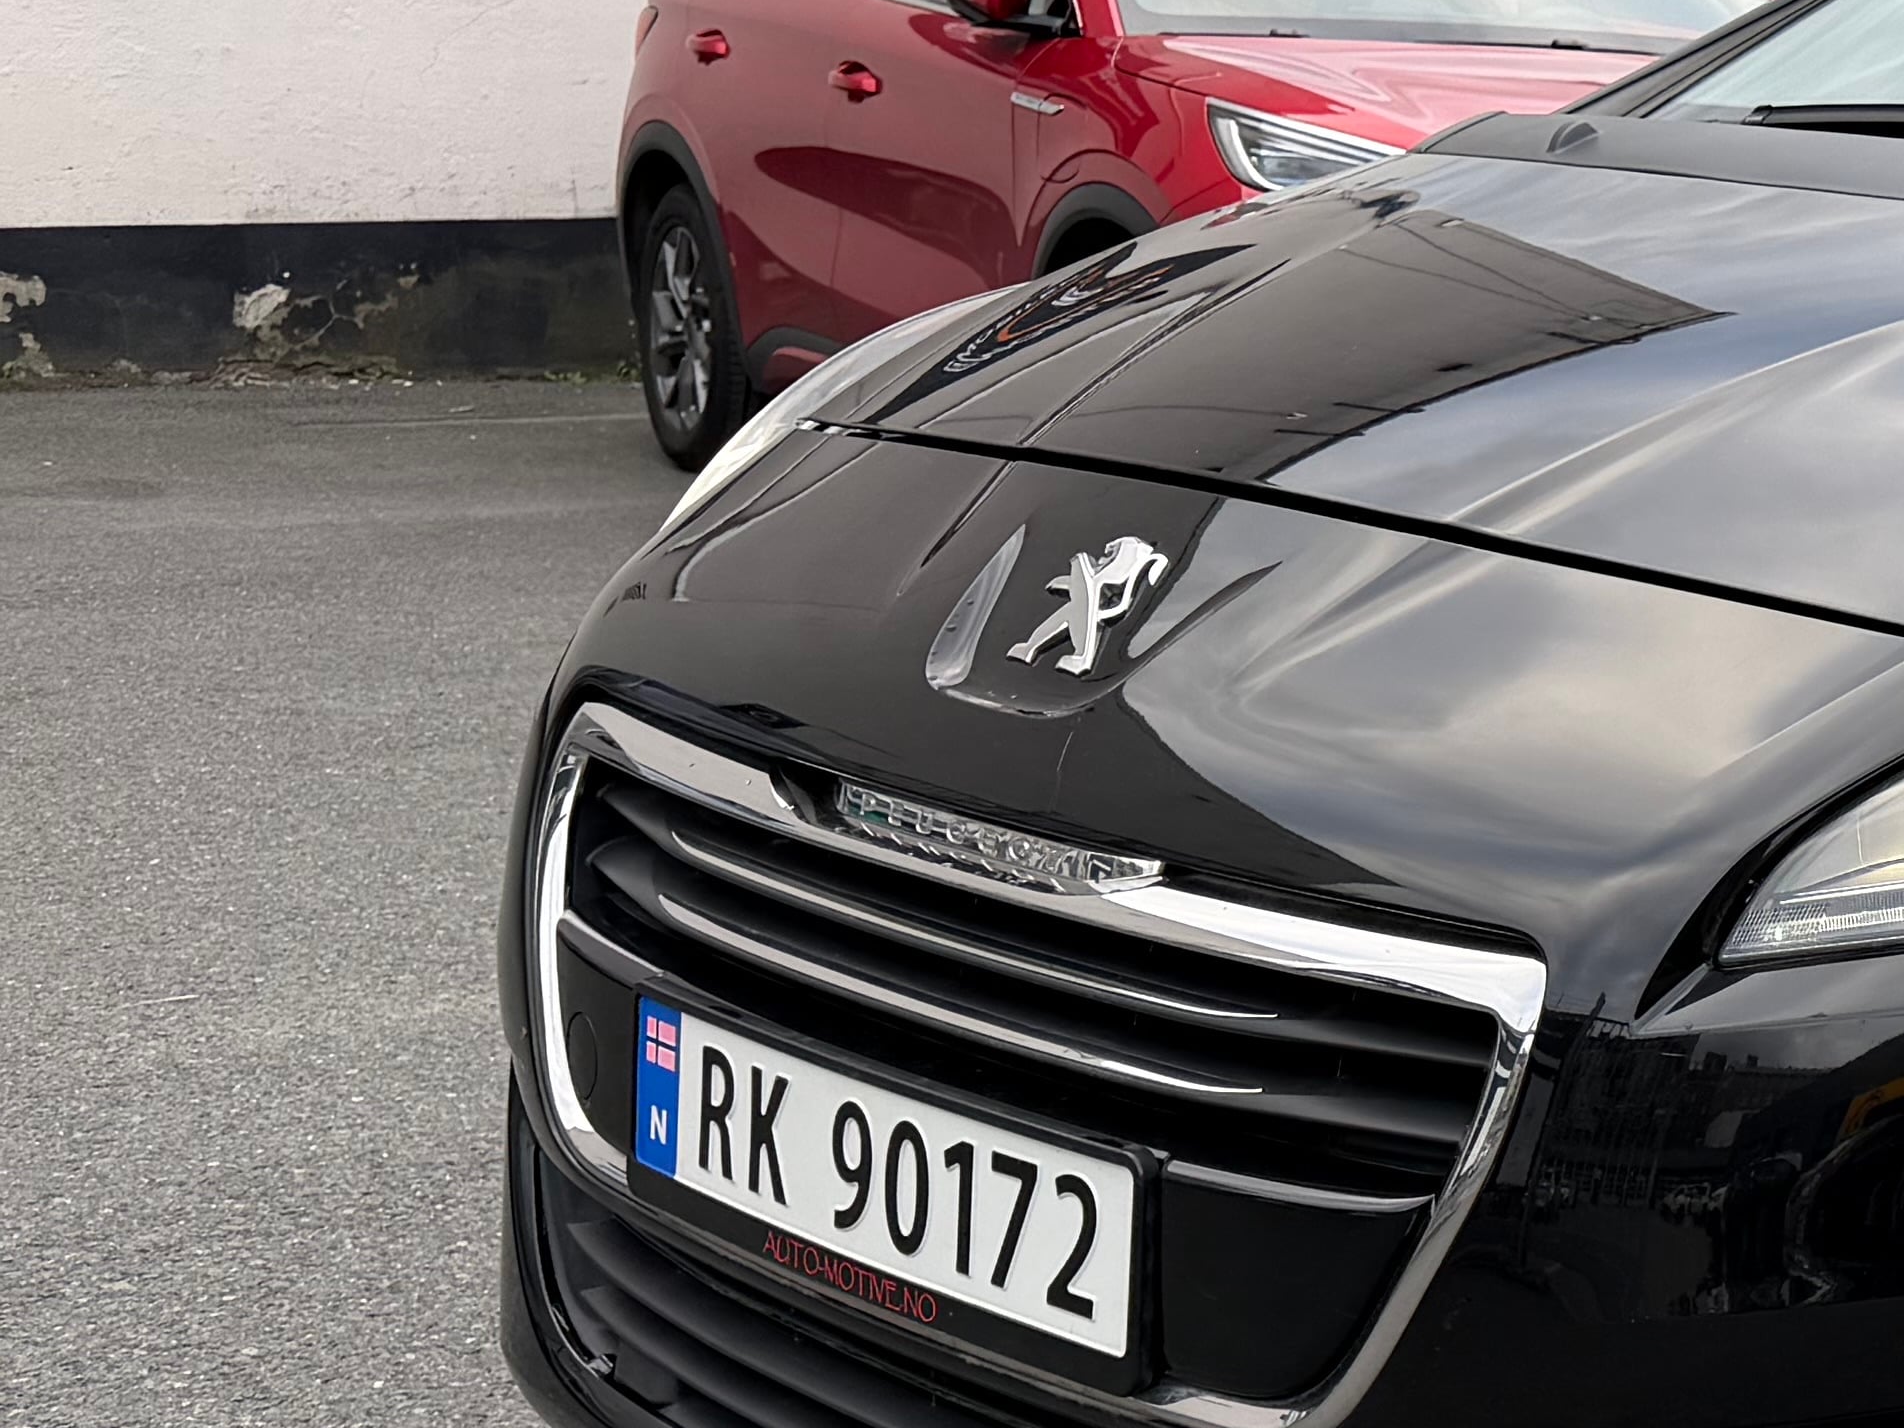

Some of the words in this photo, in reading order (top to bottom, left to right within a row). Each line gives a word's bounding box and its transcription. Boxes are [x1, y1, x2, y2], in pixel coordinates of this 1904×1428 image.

[649, 1104, 667, 1146] N
[698, 1044, 789, 1207] RK
[832, 1099, 1097, 1321] 90172
[762, 1230, 937, 1323] AUTO-MOTIVE.NO
